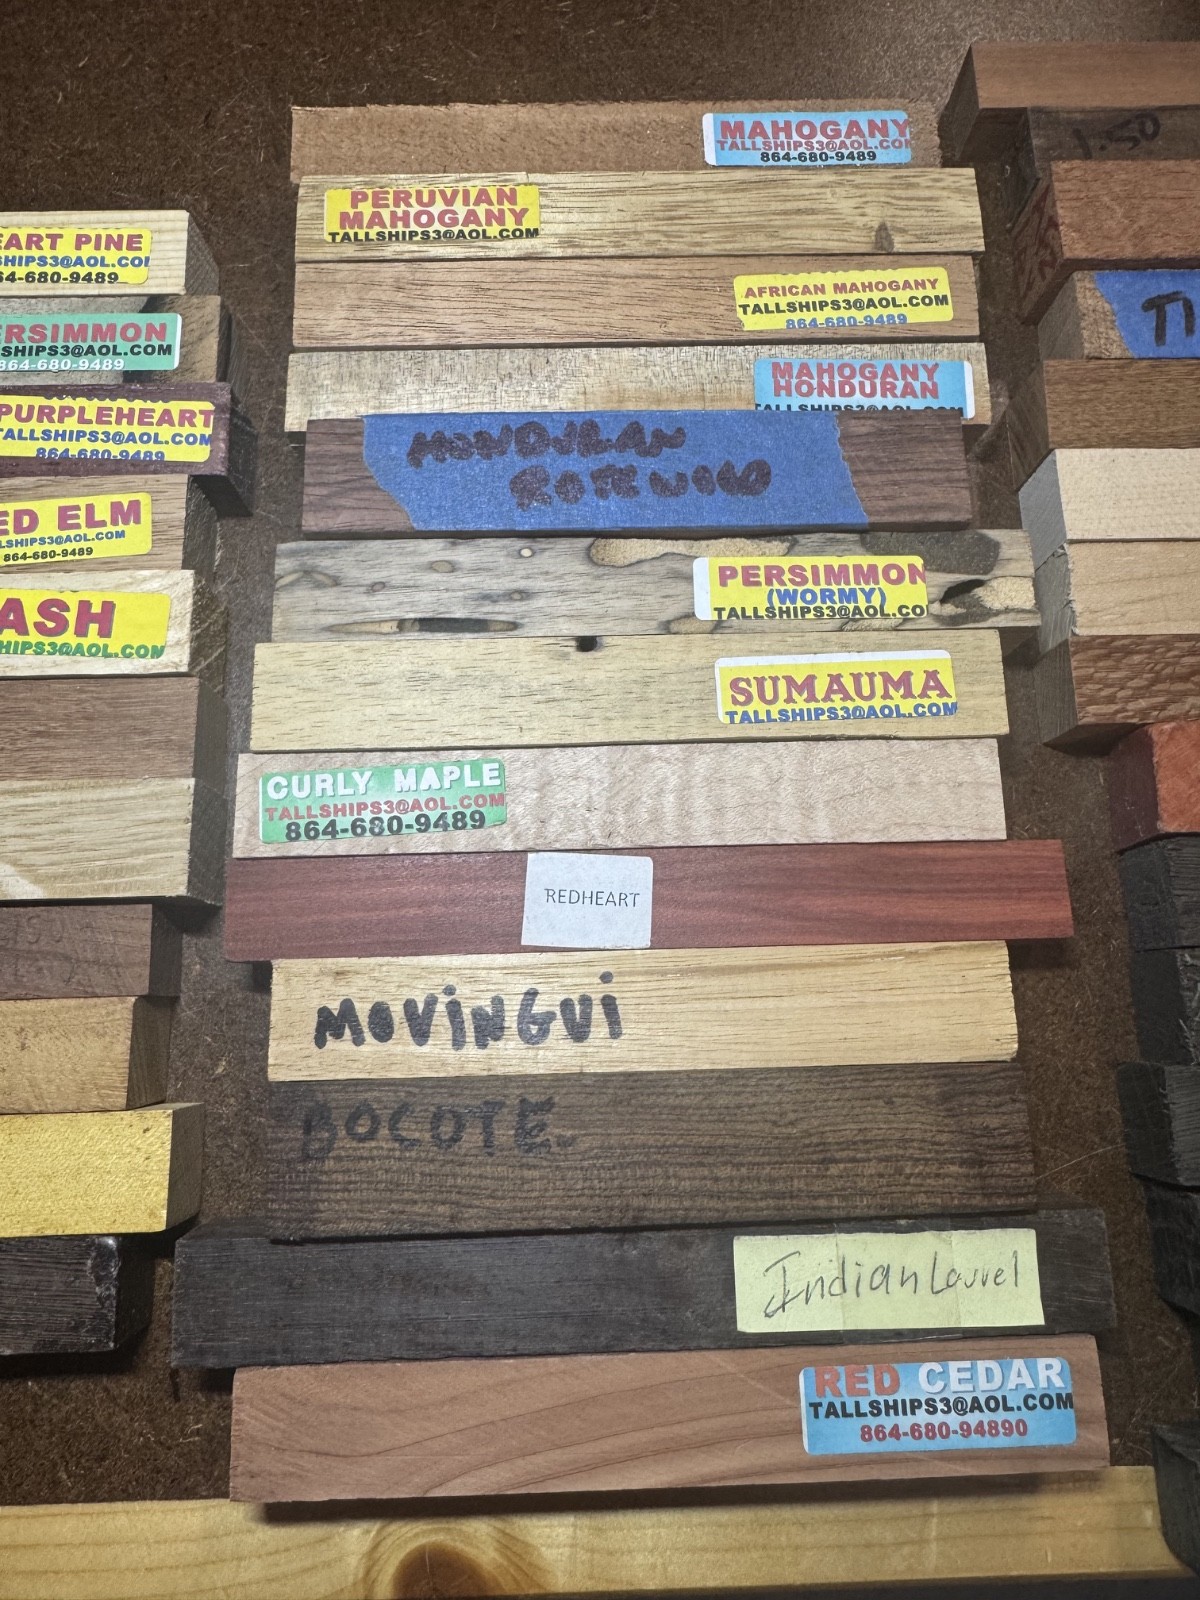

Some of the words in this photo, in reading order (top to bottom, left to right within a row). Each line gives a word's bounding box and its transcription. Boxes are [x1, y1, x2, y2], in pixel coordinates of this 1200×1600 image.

[718, 118, 911, 140] MAHOGANY
[760, 150, 877, 163] 864-680-9489
[350, 187, 518, 209] PERUVIAN
[339, 207, 530, 230] MAHOGANY
[0, 233, 64, 251] ART
[74, 234, 144, 251] PINE
[328, 227, 539, 243] TALLSHIPS3@AOL.COM
[0, 255, 150, 268] HIPS3@AOL.CO
[744, 284, 827, 299] AFRICAN
[833, 278, 939, 296] MAHOGANY
[738, 294, 950, 316] TALLSHIPS3@AOL.COM
[785, 313, 908, 330] 864-680-9489
[0, 323, 168, 344] RSIMMON
[771, 362, 940, 383] MAHOGANY
[772, 379, 940, 400] HONDURAN
[0, 403, 215, 428] PURPLEHEART
[36, 447, 166, 461] 864-680-9489
[57, 499, 142, 532] ELM
[3, 547, 94, 562] 864-680-9489
[718, 563, 927, 588] PERSIMMON
[767, 586, 887, 608] (WORMY)
[0, 597, 117, 639] ASH
[713, 605, 928, 620] TALLSHIPS3@AOL.CO
[729, 669, 953, 707] SUMAUMA
[725, 702, 958, 725] TALLSHIPS3@AOL.COM
[266, 771, 373, 801] CURLY
[394, 763, 501, 794] MAPLE
[265, 793, 506, 822] TALLSHIPS3@AOL.COM
[285, 810, 487, 842] 864-680-9489
[545, 888, 640, 908] REDHEART
[763, 1250, 919, 1318] Indian
[815, 1364, 901, 1399] RED
[918, 1357, 1067, 1394] CEDAR
[808, 1392, 1075, 1420] TALLSHIPS3@AOL.COM
[860, 1418, 1028, 1443] 864-680-94890
